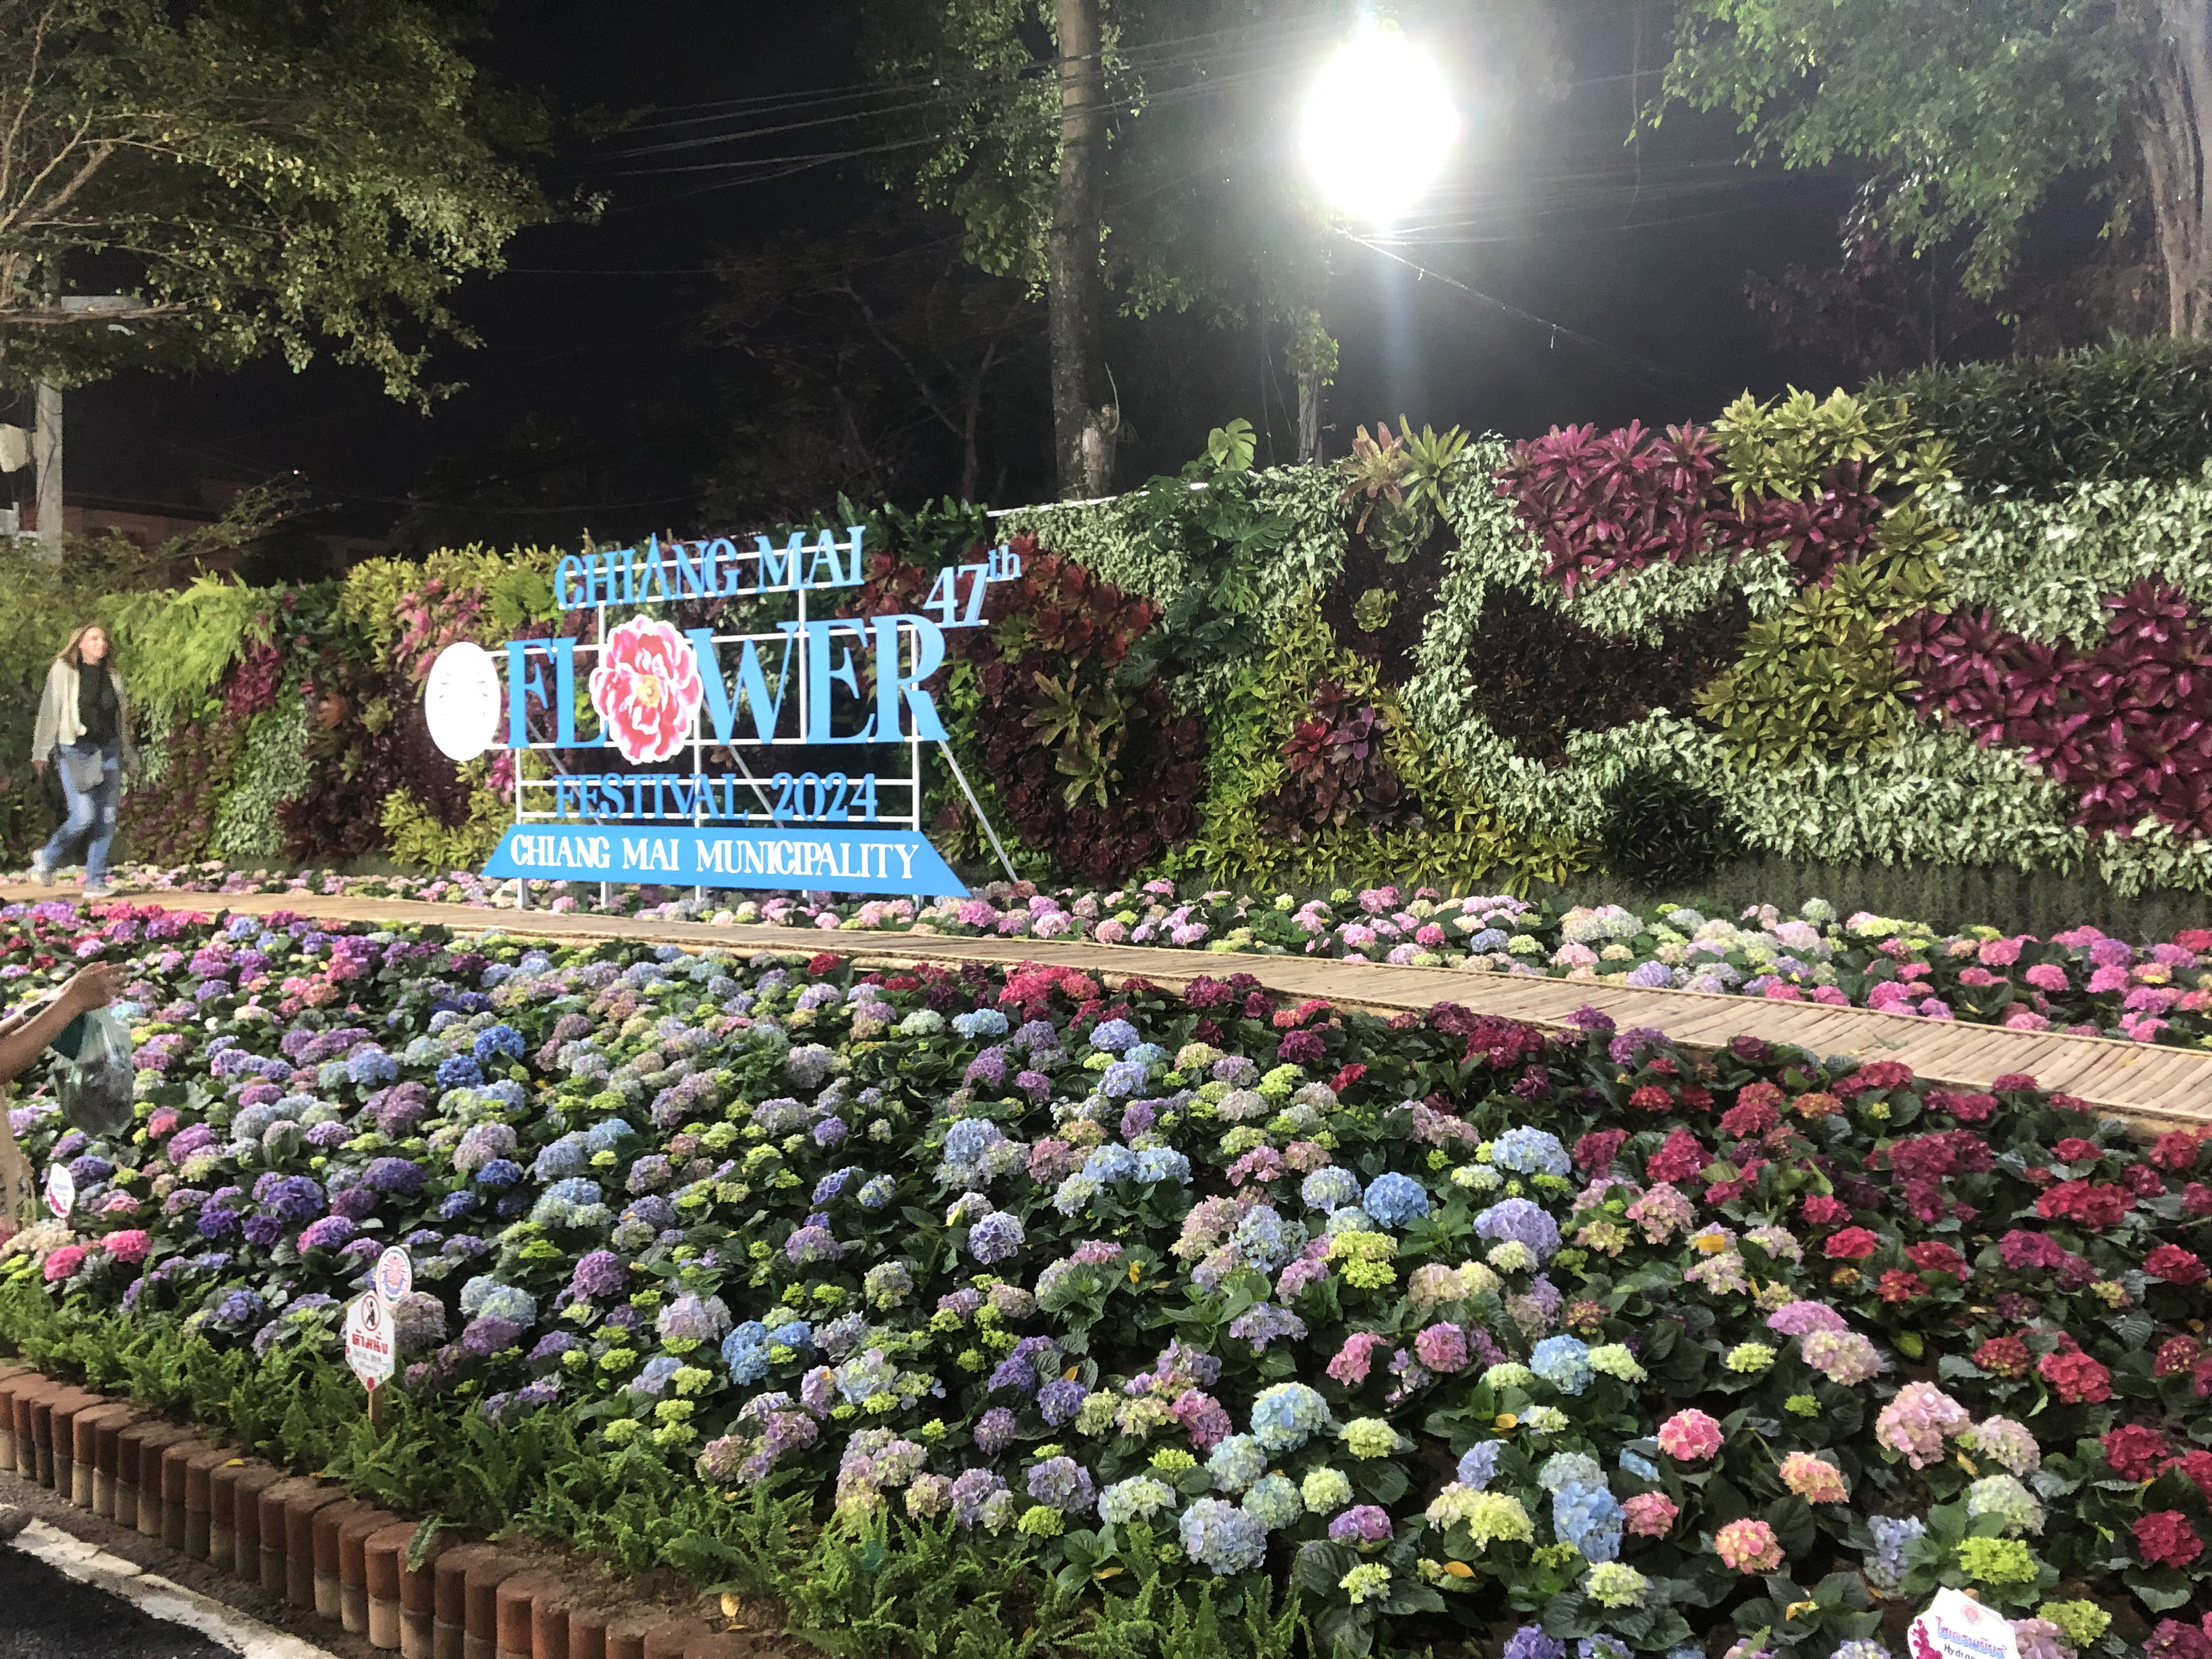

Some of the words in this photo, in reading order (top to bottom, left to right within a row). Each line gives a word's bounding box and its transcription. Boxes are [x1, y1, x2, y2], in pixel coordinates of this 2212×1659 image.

[554, 531, 740, 610] CHIANG
[754, 525, 867, 593] MAI
[923, 544, 1022, 629] 47th
[554, 773, 748, 820] FESTIVAL
[771, 772, 878, 821] 2024
[510, 833, 611, 869] CHIANG
[622, 838, 679, 871] MAI
[696, 839, 920, 879] MUNICIPALITY
